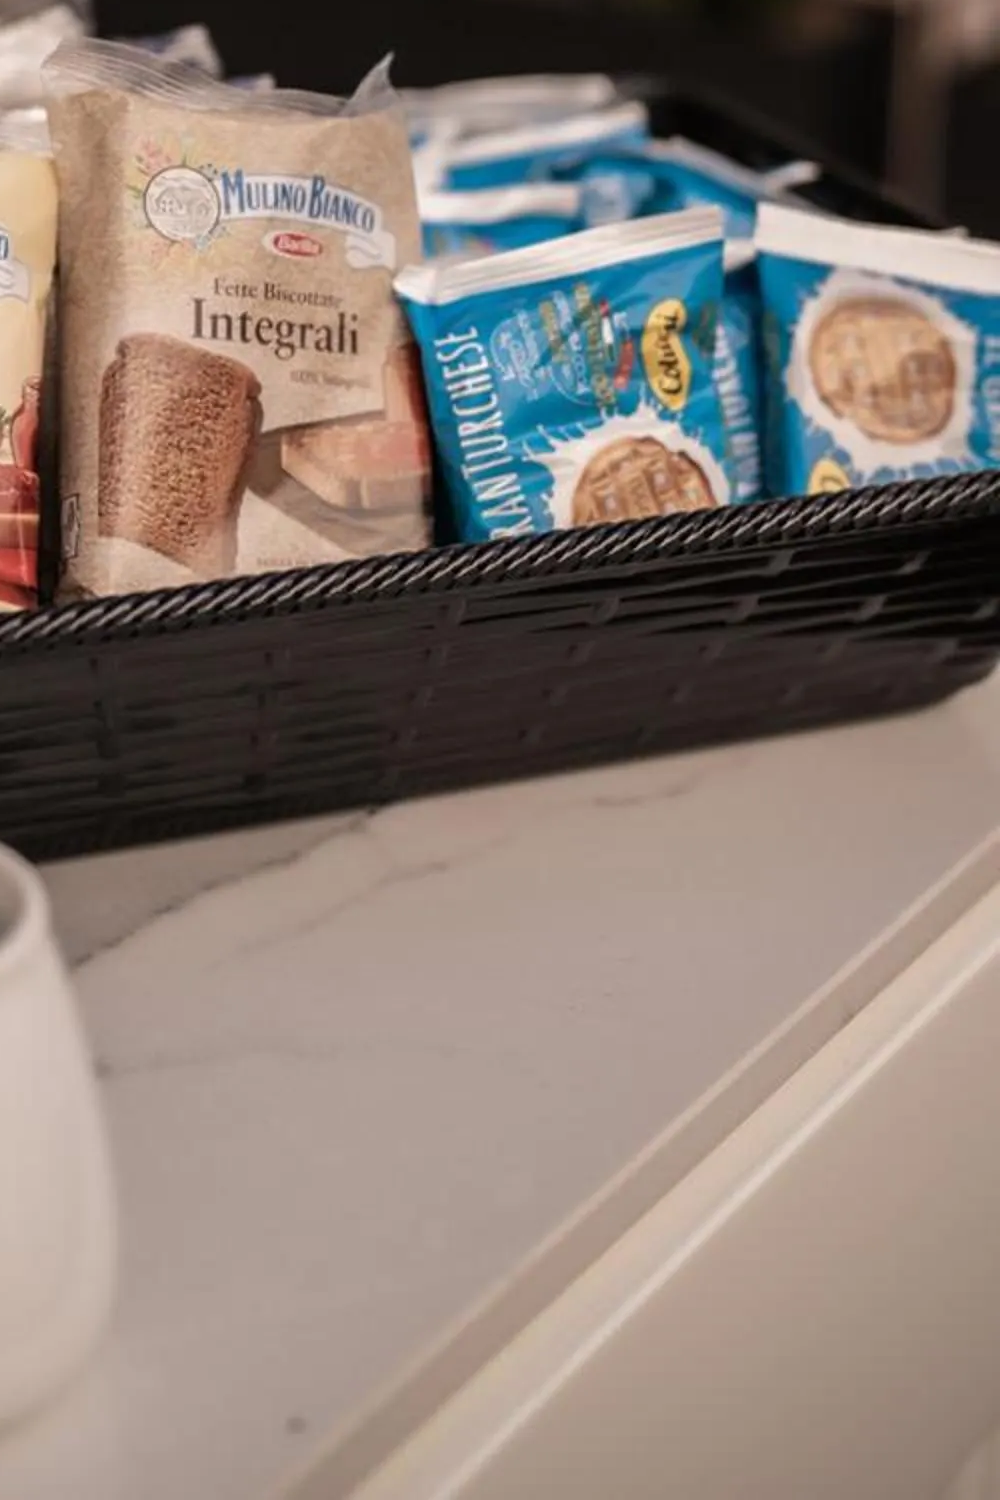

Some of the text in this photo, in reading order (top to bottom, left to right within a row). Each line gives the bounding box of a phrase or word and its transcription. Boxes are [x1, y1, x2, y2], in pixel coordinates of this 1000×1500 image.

[221, 168, 375, 233] MULINO BIANCO
[213, 277, 258, 299] Fette
[190, 298, 359, 360] Integrali
[434, 326, 536, 542] RANTURCHESE
